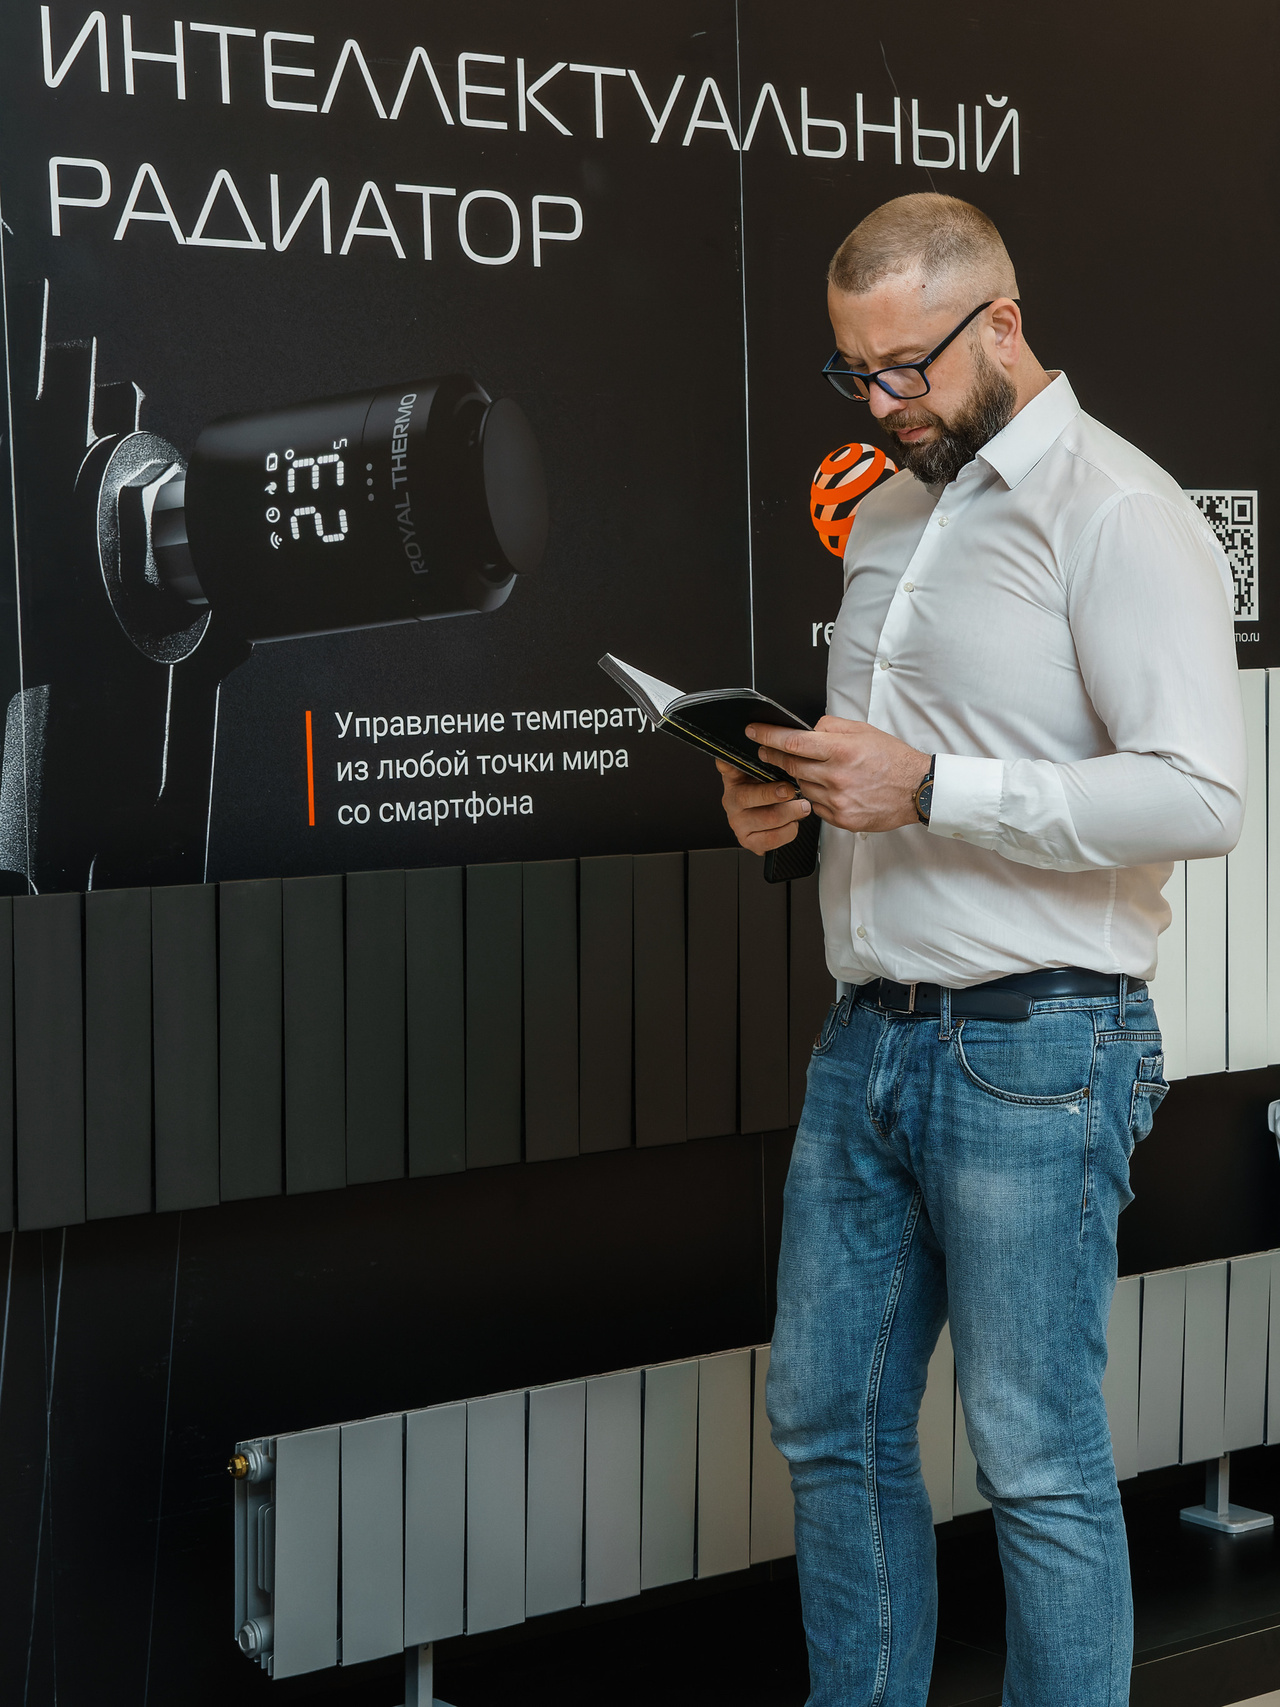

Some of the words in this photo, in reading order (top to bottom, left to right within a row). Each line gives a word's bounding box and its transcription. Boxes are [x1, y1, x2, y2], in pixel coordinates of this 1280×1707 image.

[41, 5, 1020, 175] ИНТЕЛЛЕКТУАЛЬНЫЙ
[49, 156, 583, 267] РАДИАТОР
[392, 393, 417, 489] THERMO
[392, 494, 429, 575] ROYAL
[335, 710, 505, 743] Управление
[511, 706, 657, 734] температу
[337, 758, 369, 781] из
[377, 751, 469, 779] любой
[476, 750, 554, 775] точки
[563, 746, 629, 774] мира
[337, 801, 370, 824] со
[378, 792, 534, 825] смартфона
